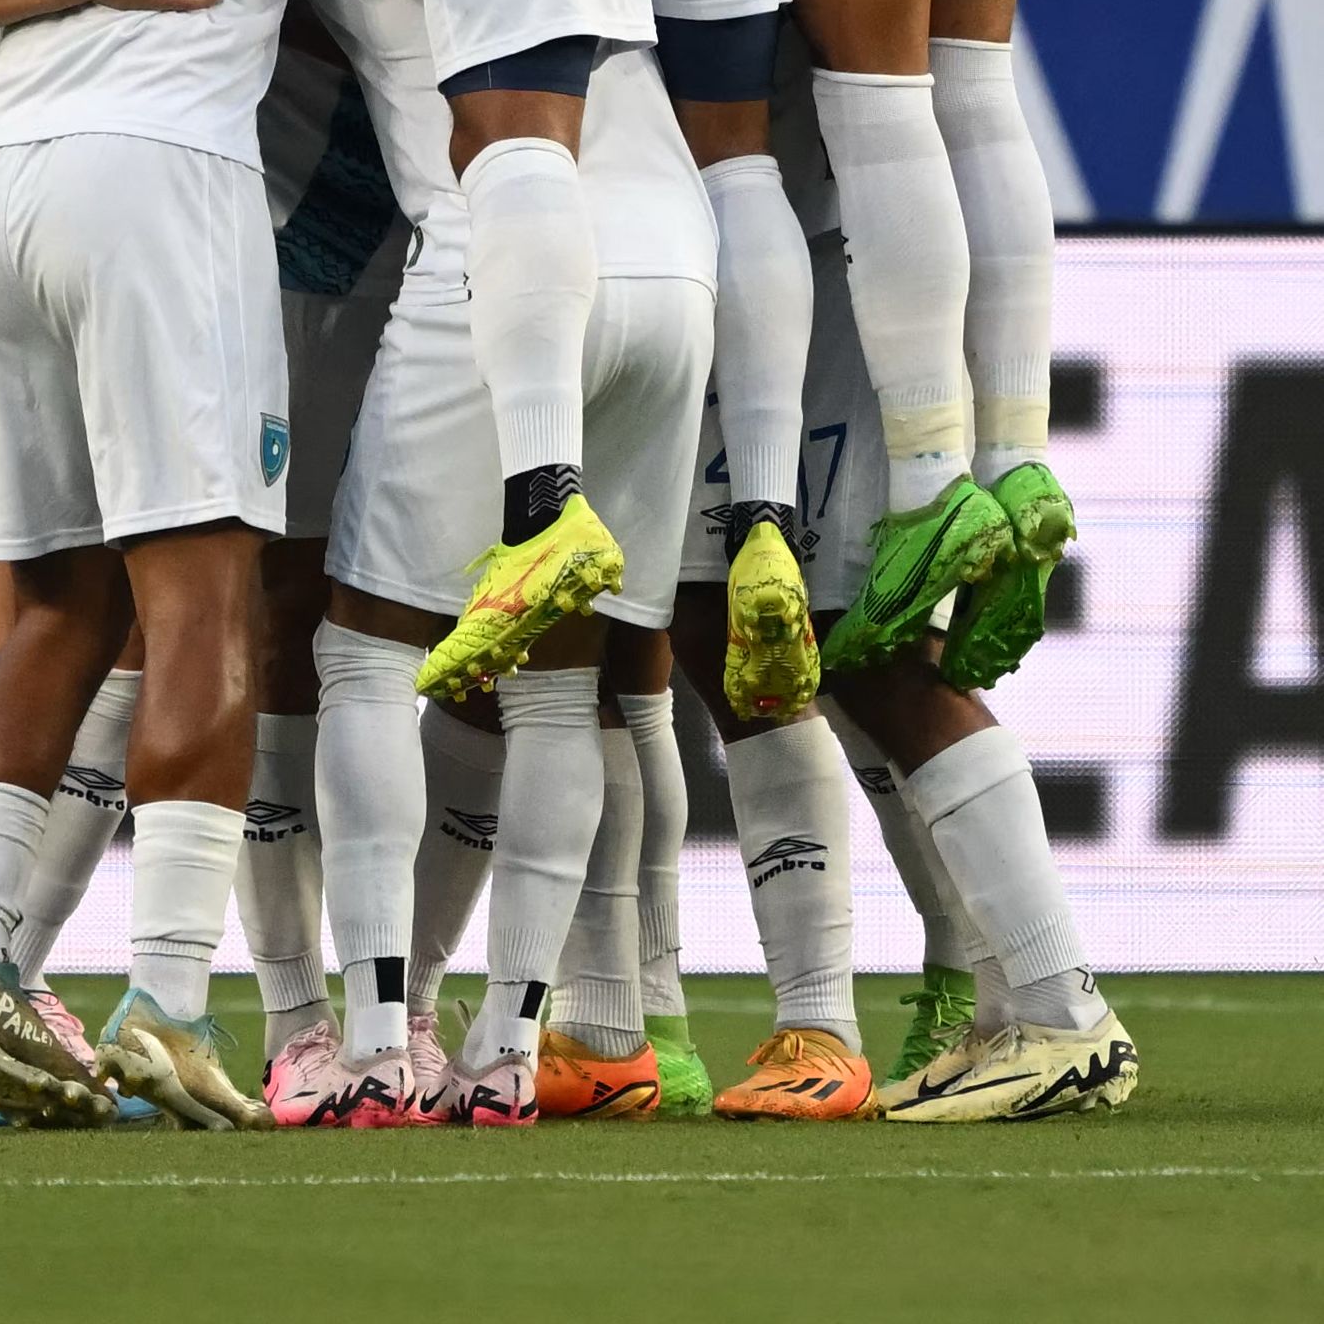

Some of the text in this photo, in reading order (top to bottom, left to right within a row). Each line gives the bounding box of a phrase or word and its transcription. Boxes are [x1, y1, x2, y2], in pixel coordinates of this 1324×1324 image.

[59, 784, 125, 811] mbro
[243, 823, 308, 844] mbro
[439, 821, 498, 852] umb
[753, 858, 826, 889] umbro
